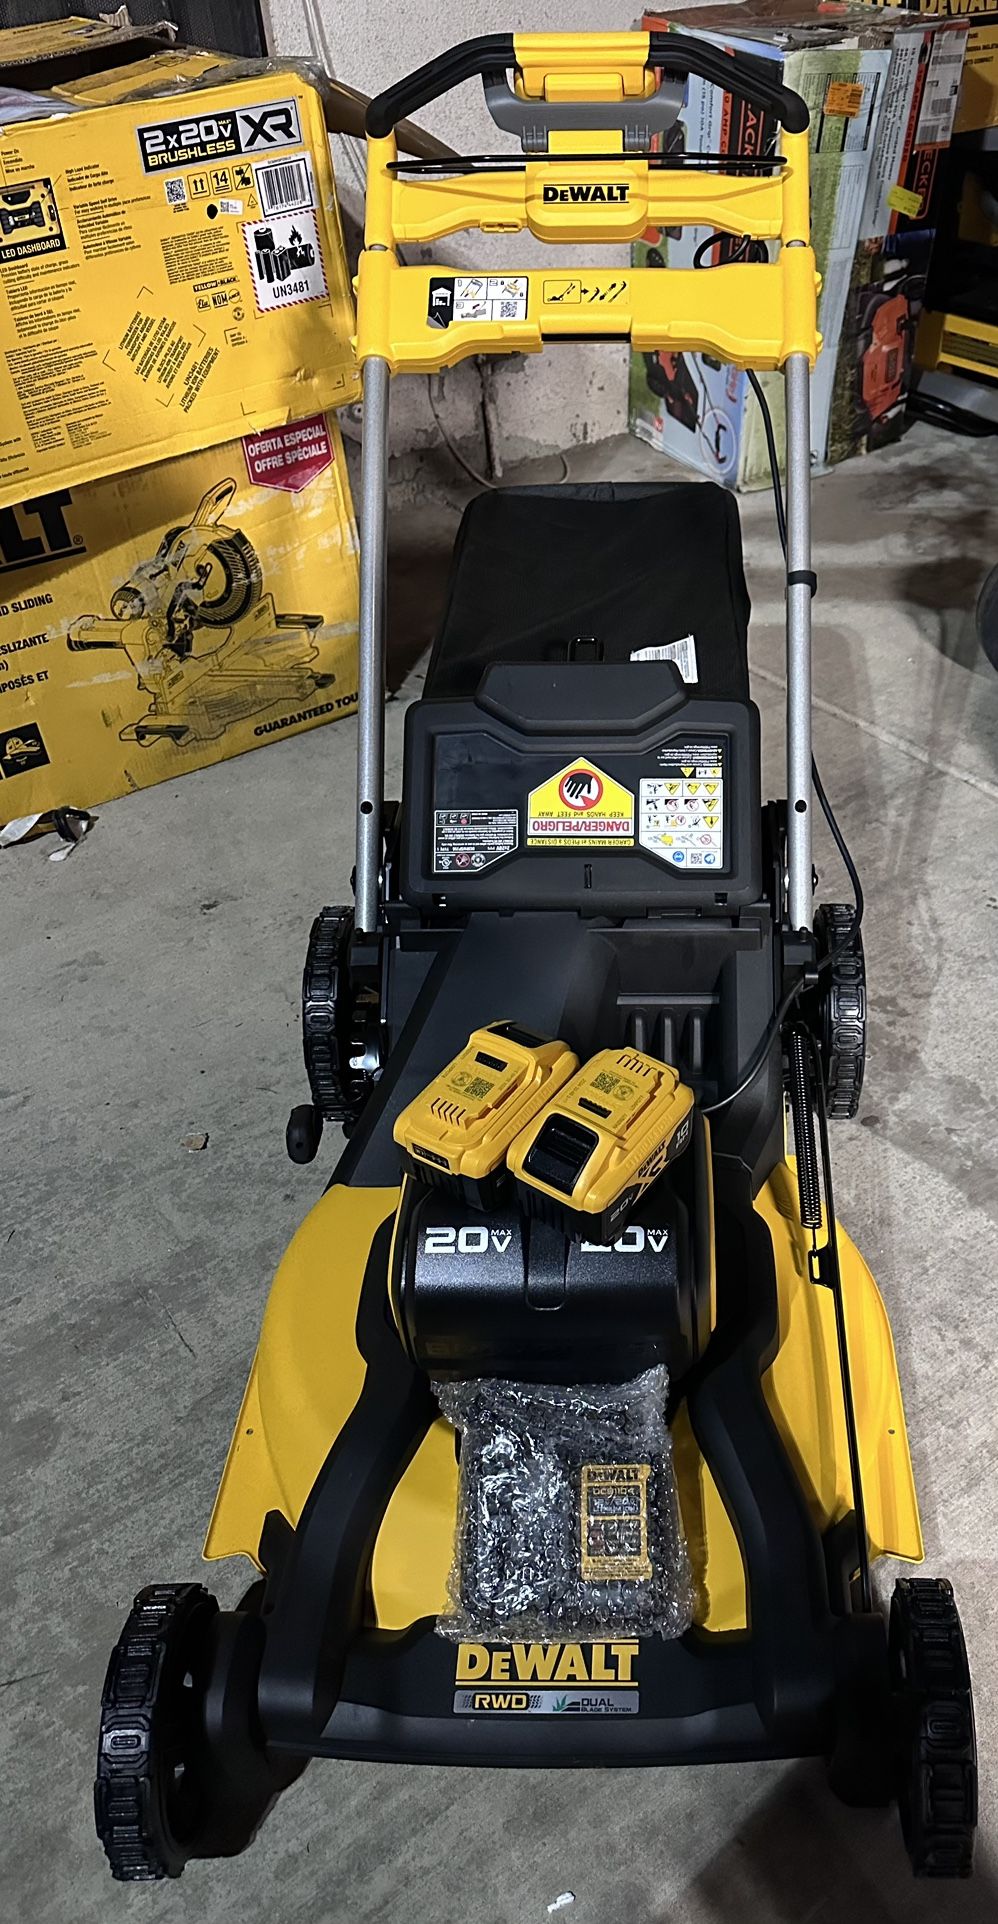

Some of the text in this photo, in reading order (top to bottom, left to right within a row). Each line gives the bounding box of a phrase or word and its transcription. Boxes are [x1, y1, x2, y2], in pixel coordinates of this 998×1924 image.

[240, 107, 296, 148] XR
[148, 140, 236, 167] BRUSHLESS
[212, 171, 228, 186] 14
[543, 186, 629, 202] DeWALT
[0, 238, 61, 259] LED DASHBOARD
[213, 293, 227, 306] NOM
[273, 280, 310, 298] UN3481
[126, 310, 141, 333] BATTERIES
[178, 346, 214, 406] LITHIUM ION BATTERIES
[182, 361, 199, 385] UN3481
[182, 347, 221, 412] PACKED WITH EQUIPMENT
[248, 424, 326, 458] OFERTA ESPECIAL
[254, 442, 327, 473] OFFRE SPÉCIALE
[0, 489, 72, 562] LT
[13, 594, 53, 612] SLIDING
[0, 632, 49, 656] SLIZANTE
[0, 671, 49, 694] POSÉS ET
[254, 702, 335, 736] GUARANTEED
[532, 821, 629, 832] DANGER/PELIGRO
[425, 1226, 512, 1254] 20V
[581, 1226, 668, 1252] 0V
[456, 1644, 639, 1680] DeWALT
[474, 1694, 527, 1709] RWD
[581, 1698, 614, 1706] DUAL
